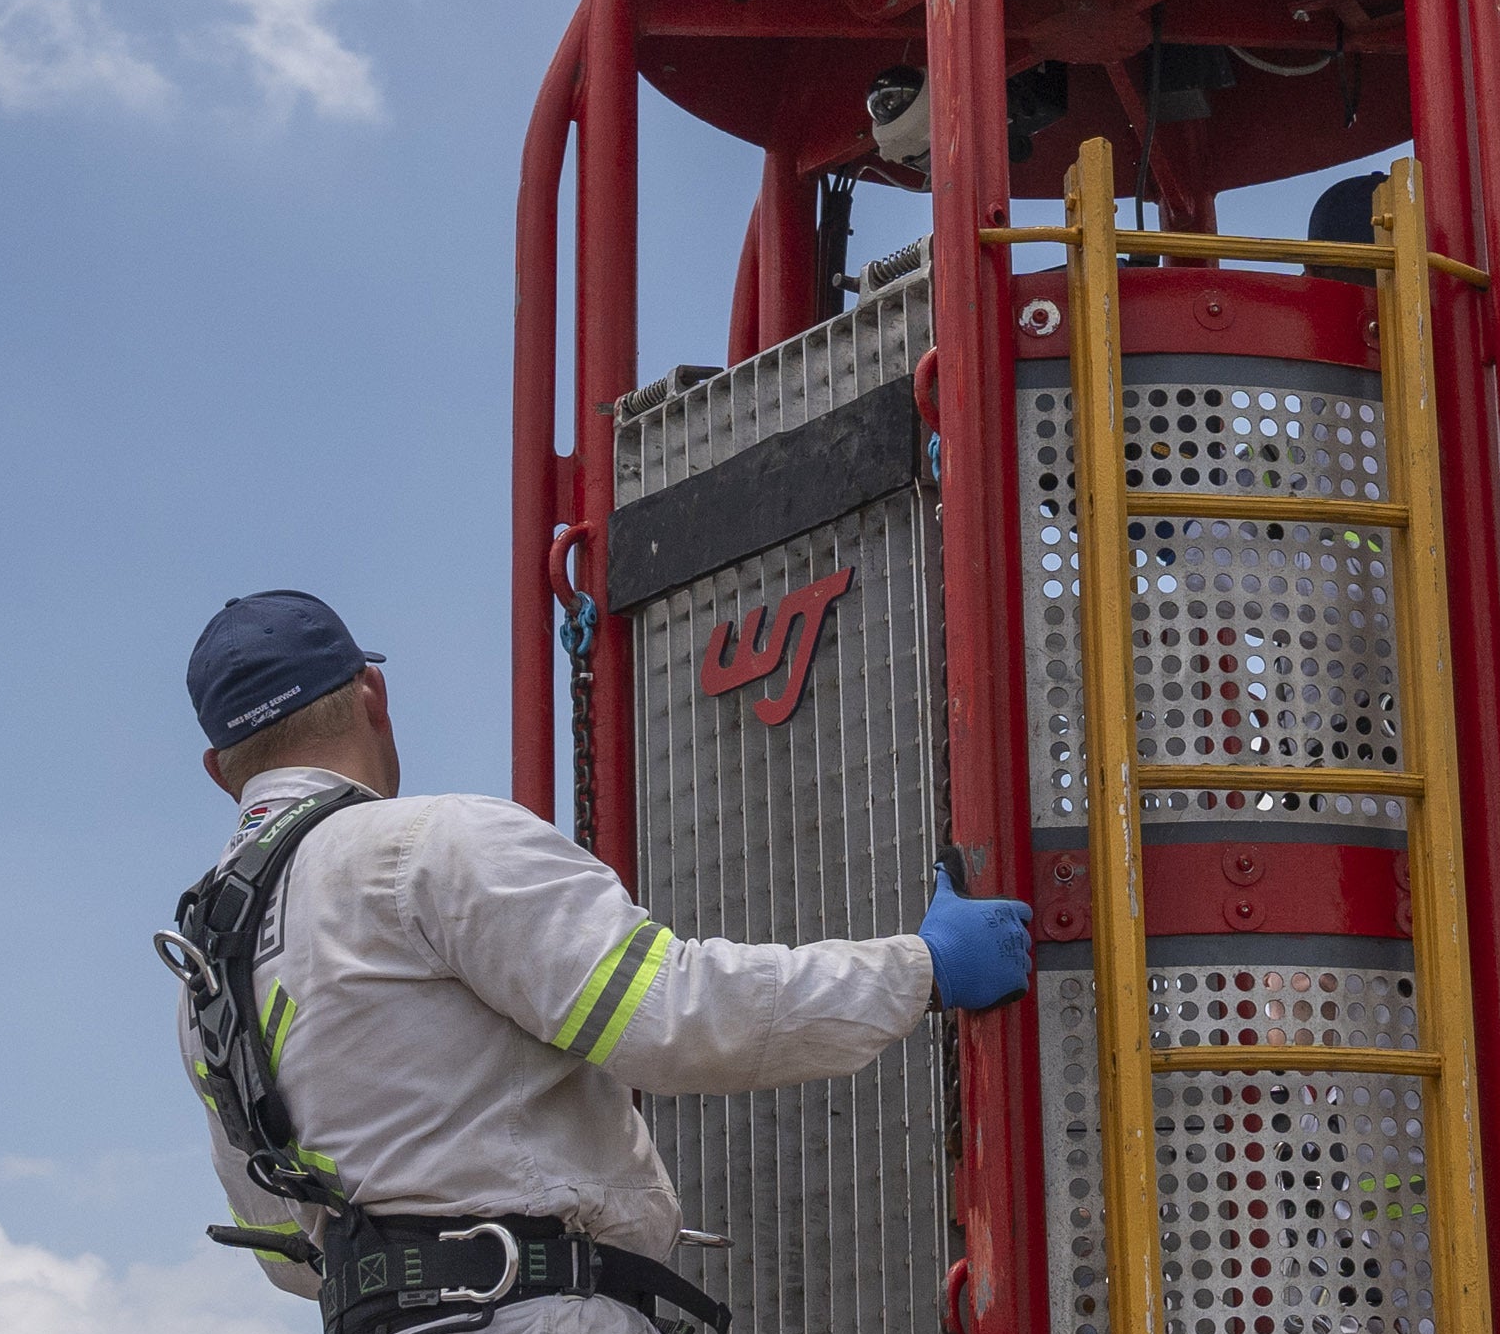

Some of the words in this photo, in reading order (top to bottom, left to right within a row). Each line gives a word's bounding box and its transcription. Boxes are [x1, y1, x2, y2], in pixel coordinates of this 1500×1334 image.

[244, 701, 269, 720] RESCUE
[269, 685, 302, 709] SERVICES
[257, 797, 318, 849] MSA
